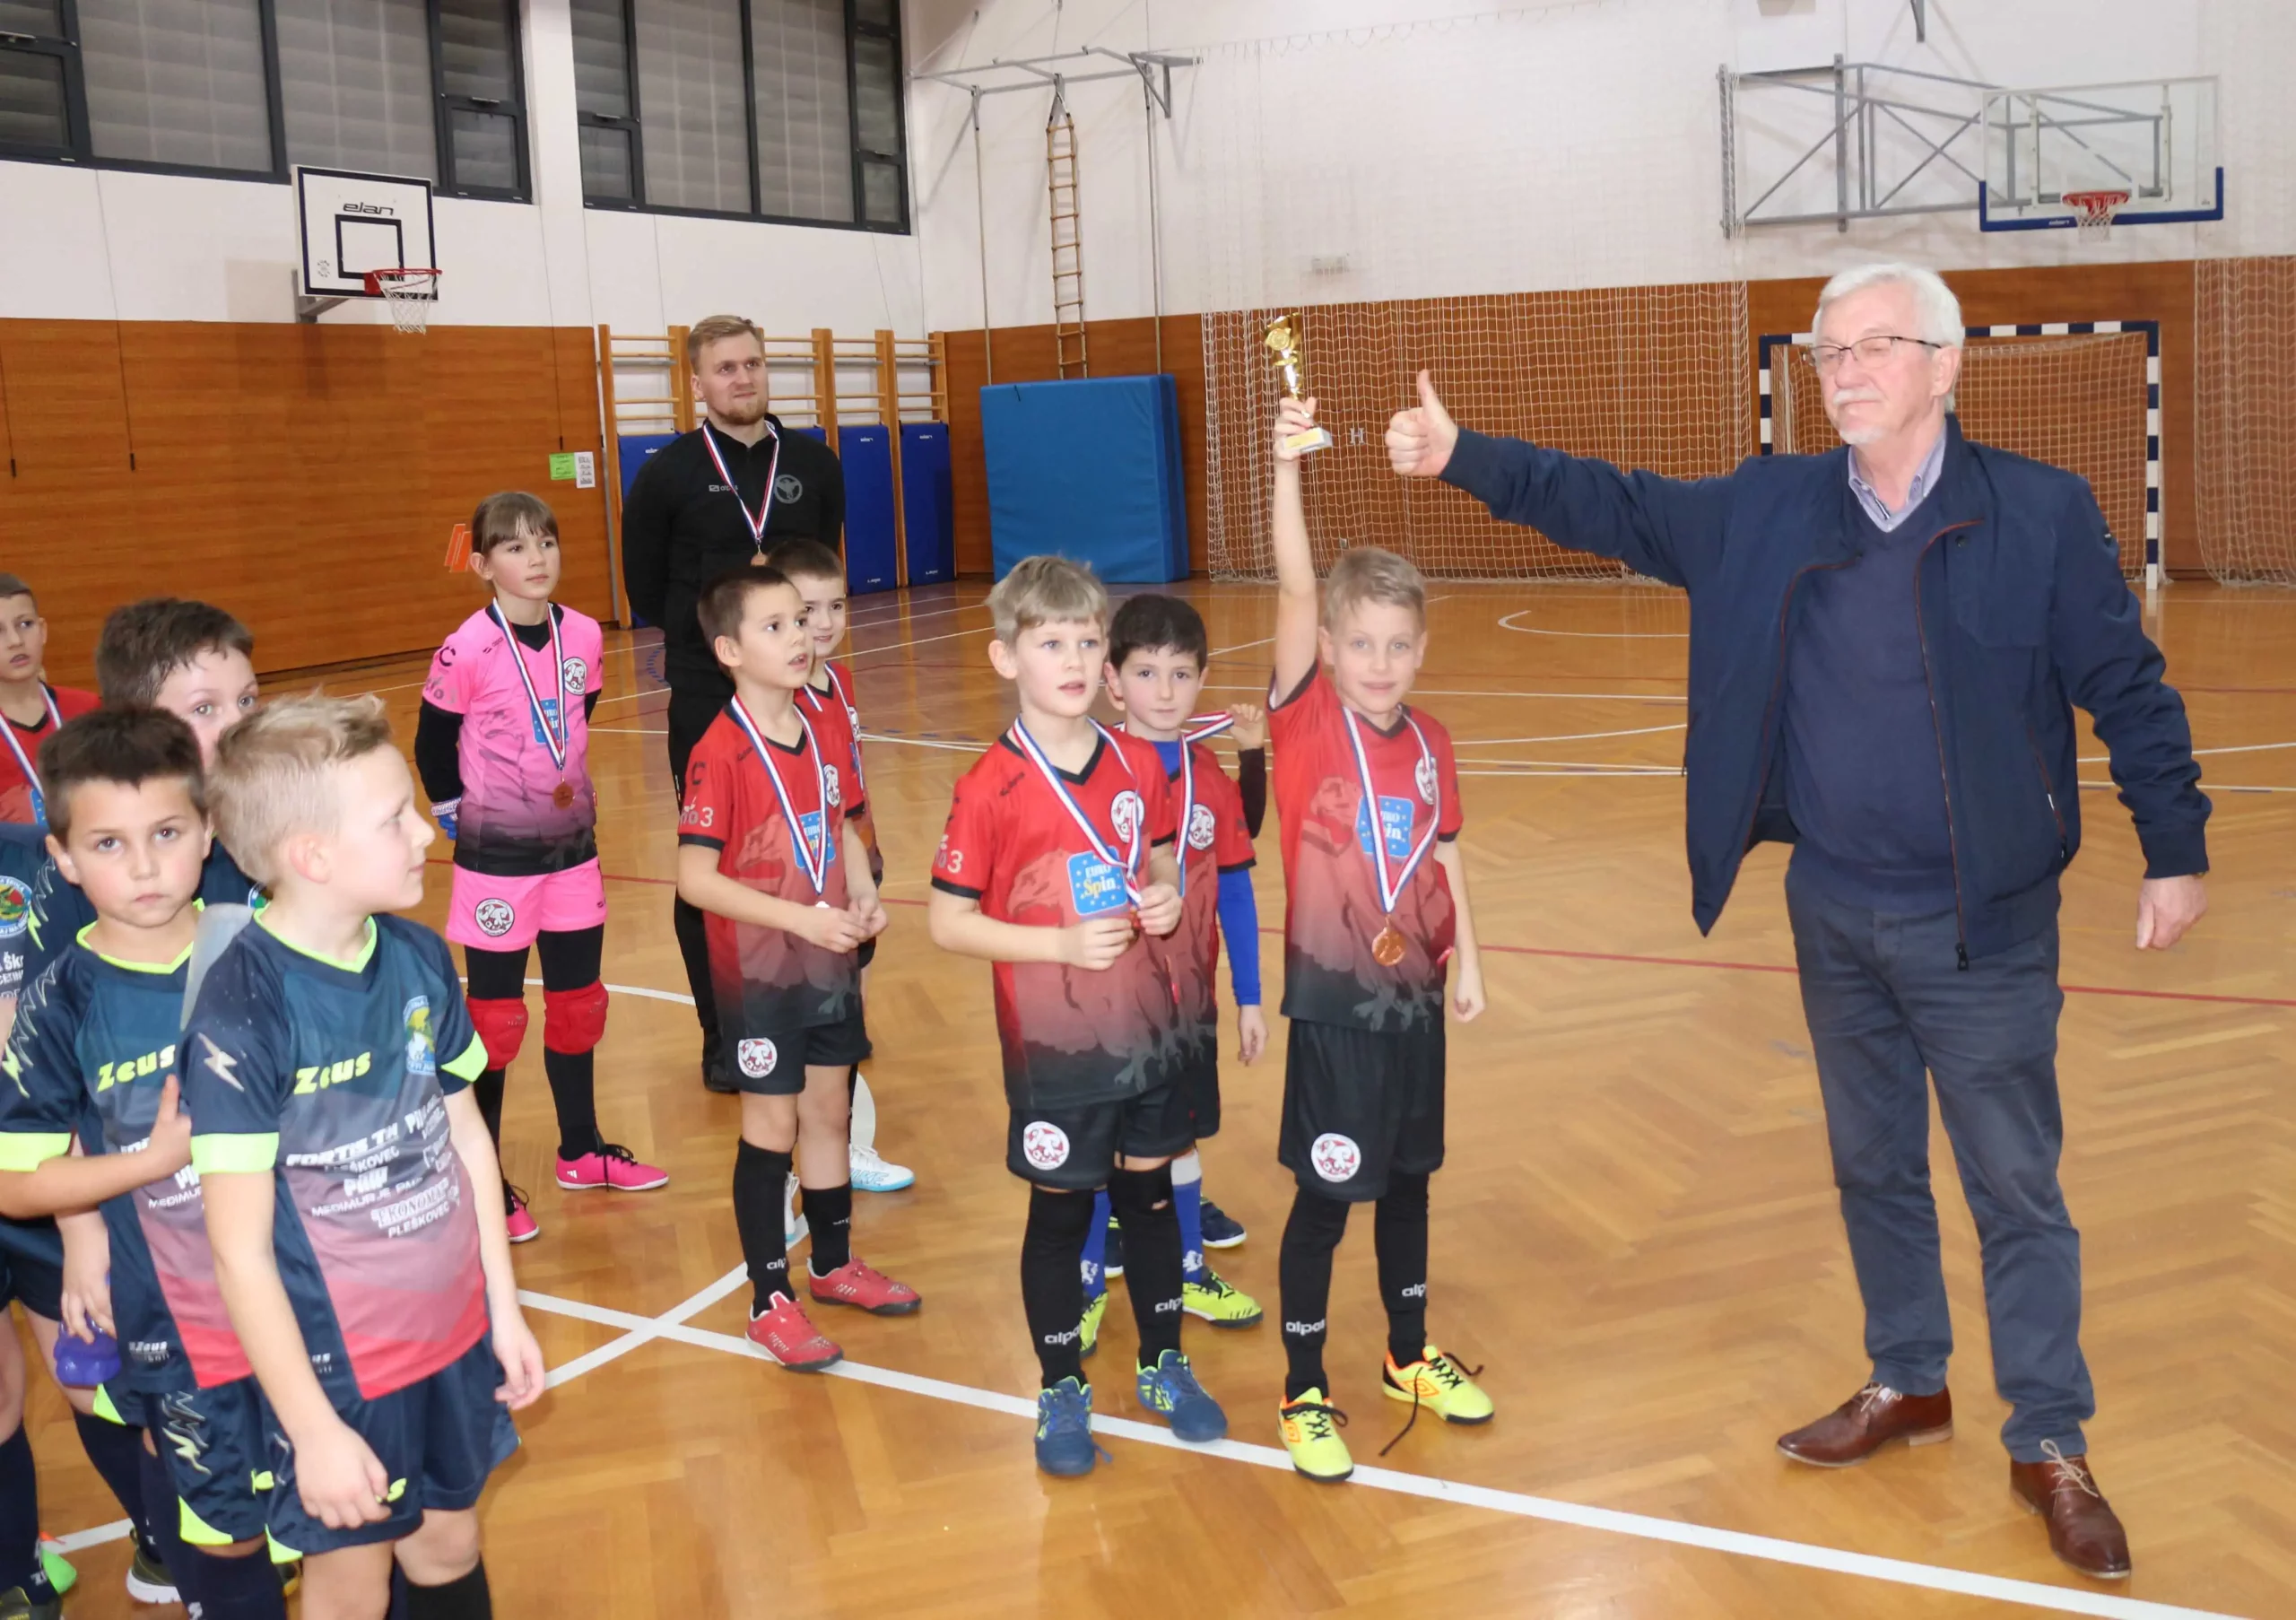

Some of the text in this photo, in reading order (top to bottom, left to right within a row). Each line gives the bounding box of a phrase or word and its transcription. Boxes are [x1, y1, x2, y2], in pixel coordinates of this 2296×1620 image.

[343, 202, 395, 216] elan
[1083, 875, 1117, 899] Spin
[97, 1044, 176, 1093] Zeus
